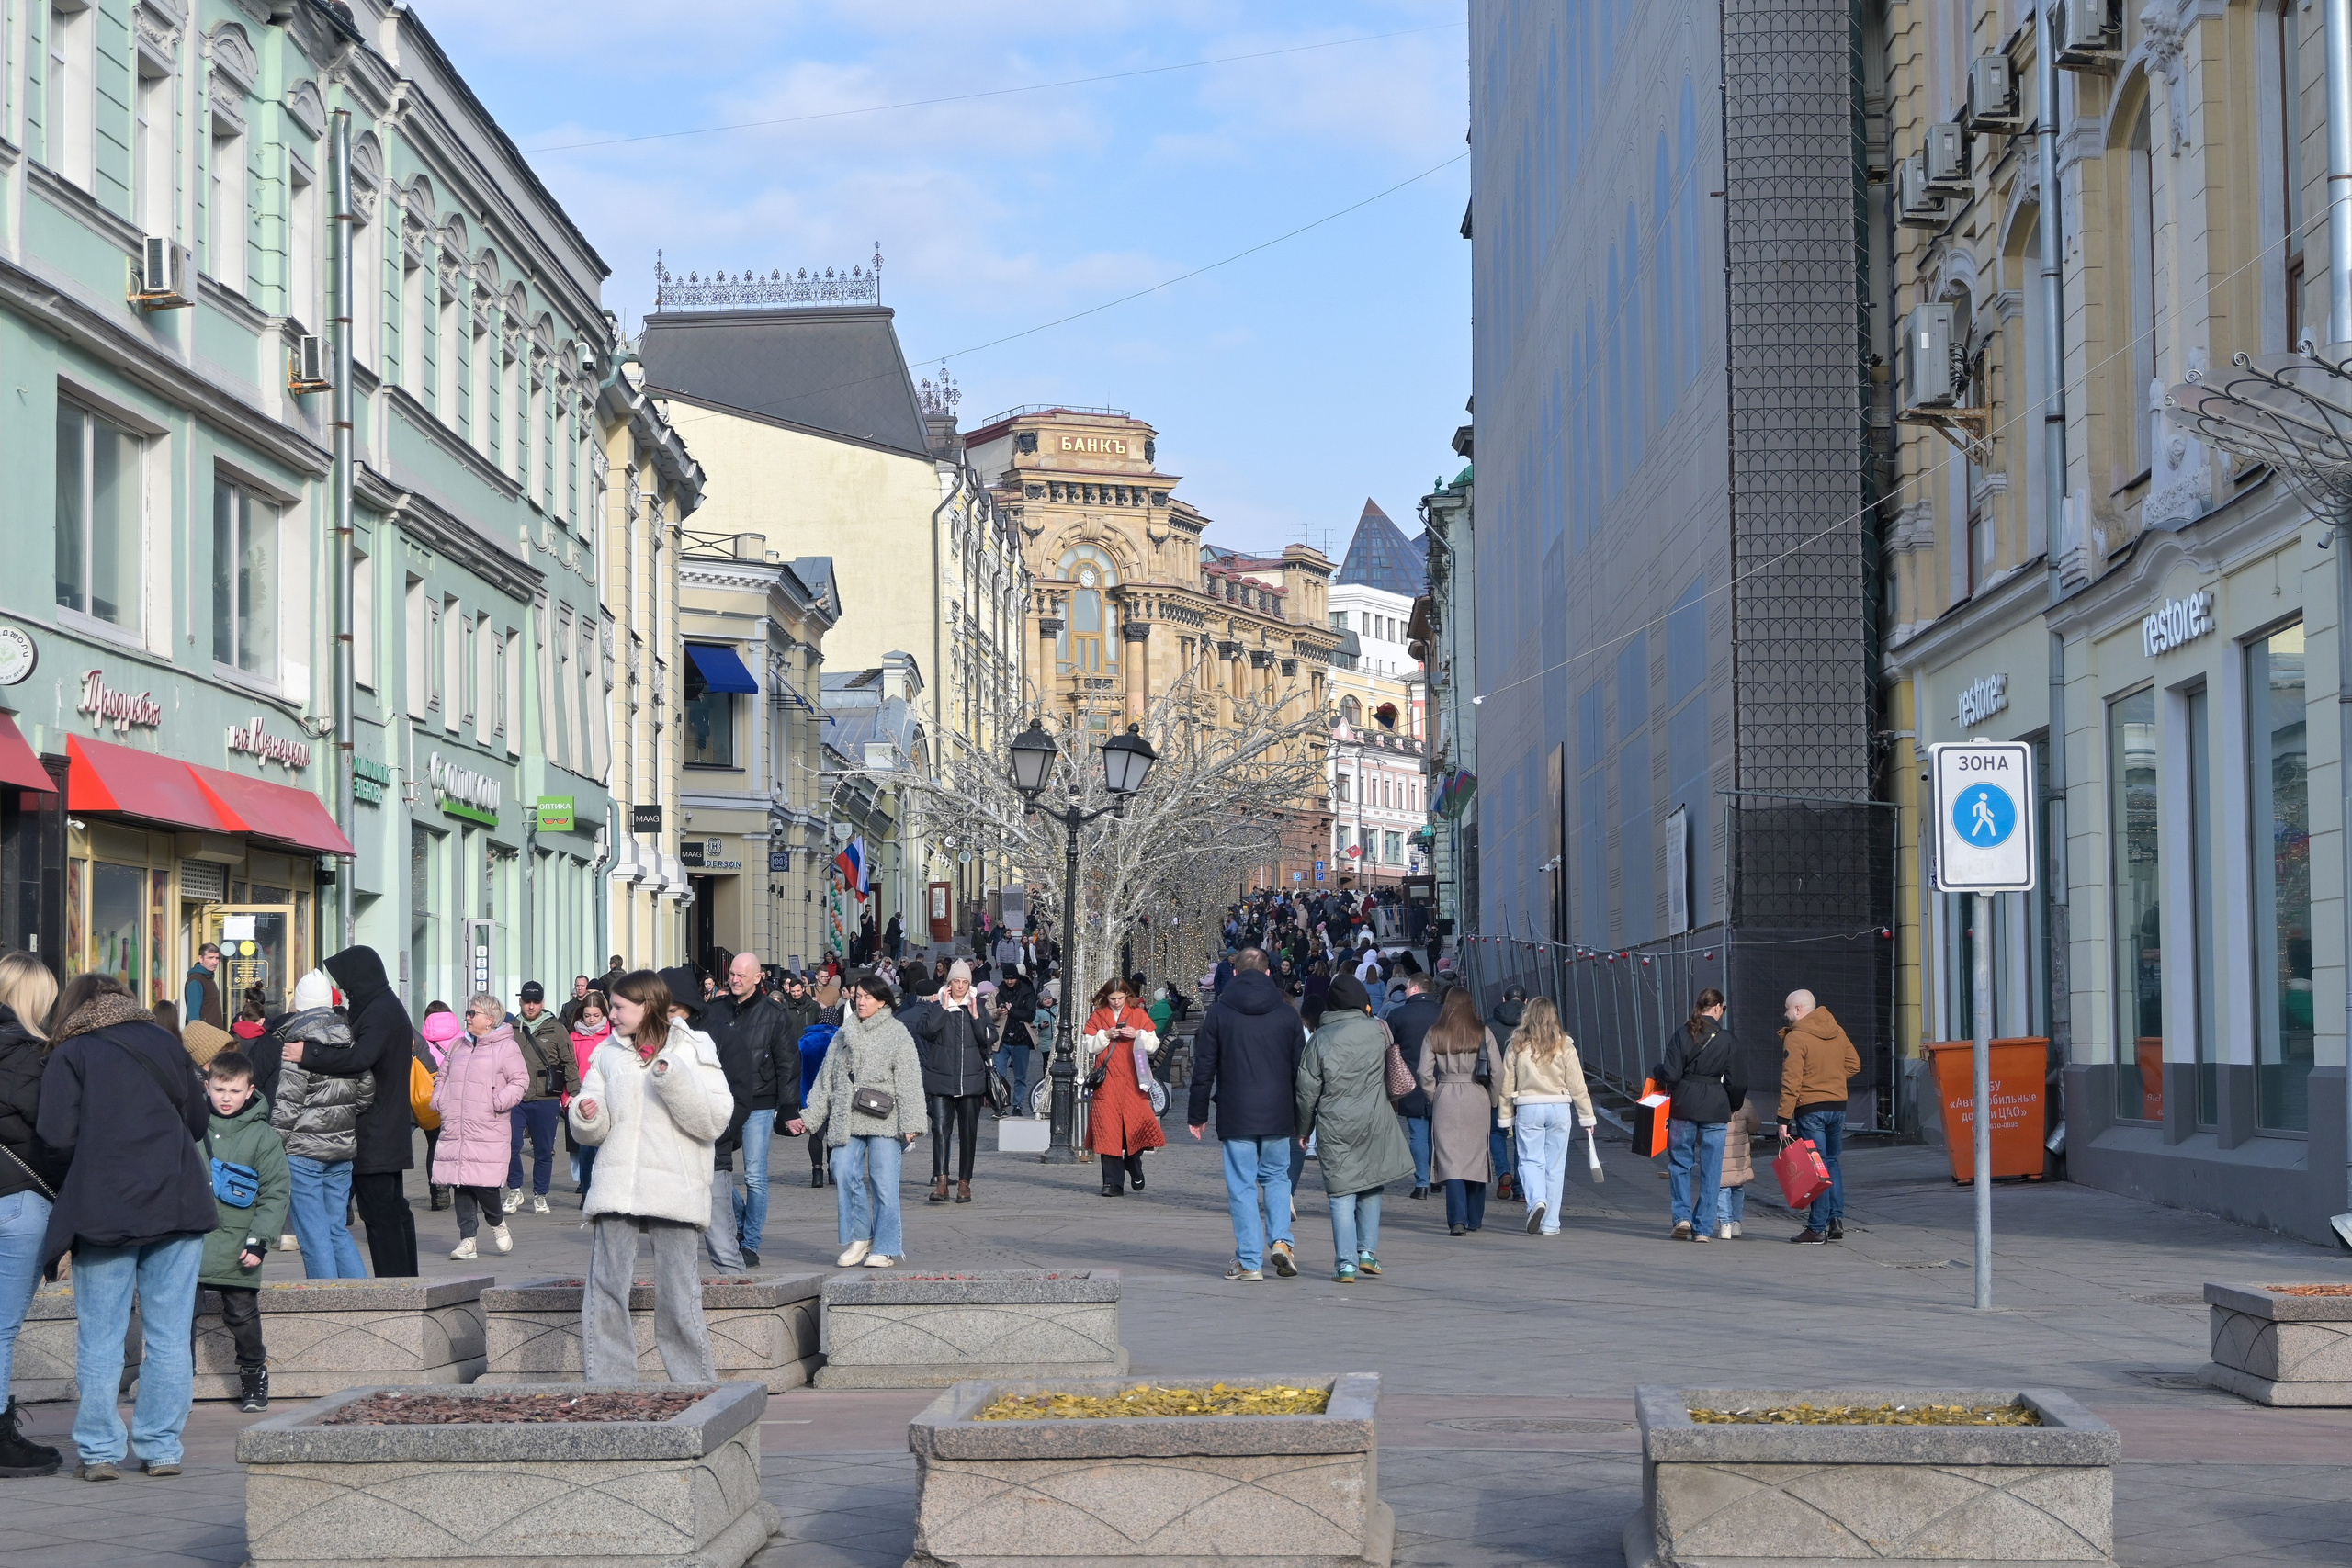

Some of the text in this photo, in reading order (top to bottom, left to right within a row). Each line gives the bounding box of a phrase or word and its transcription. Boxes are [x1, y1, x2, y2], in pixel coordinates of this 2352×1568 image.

[1061, 436, 1126, 454] БАНКЪ
[83, 670, 311, 767] Продукты на Кузнецком
[1958, 755, 2009, 771] ЗОНА
[538, 802, 571, 810] ОПТИКА
[635, 815, 660, 823] MAAG
[704, 860, 741, 870] DERSON
[1989, 1080, 2001, 1092] БУ
[1950, 1093, 2037, 1109] «Автобильные
[1962, 1106, 2027, 1123] дои ЦАО»
